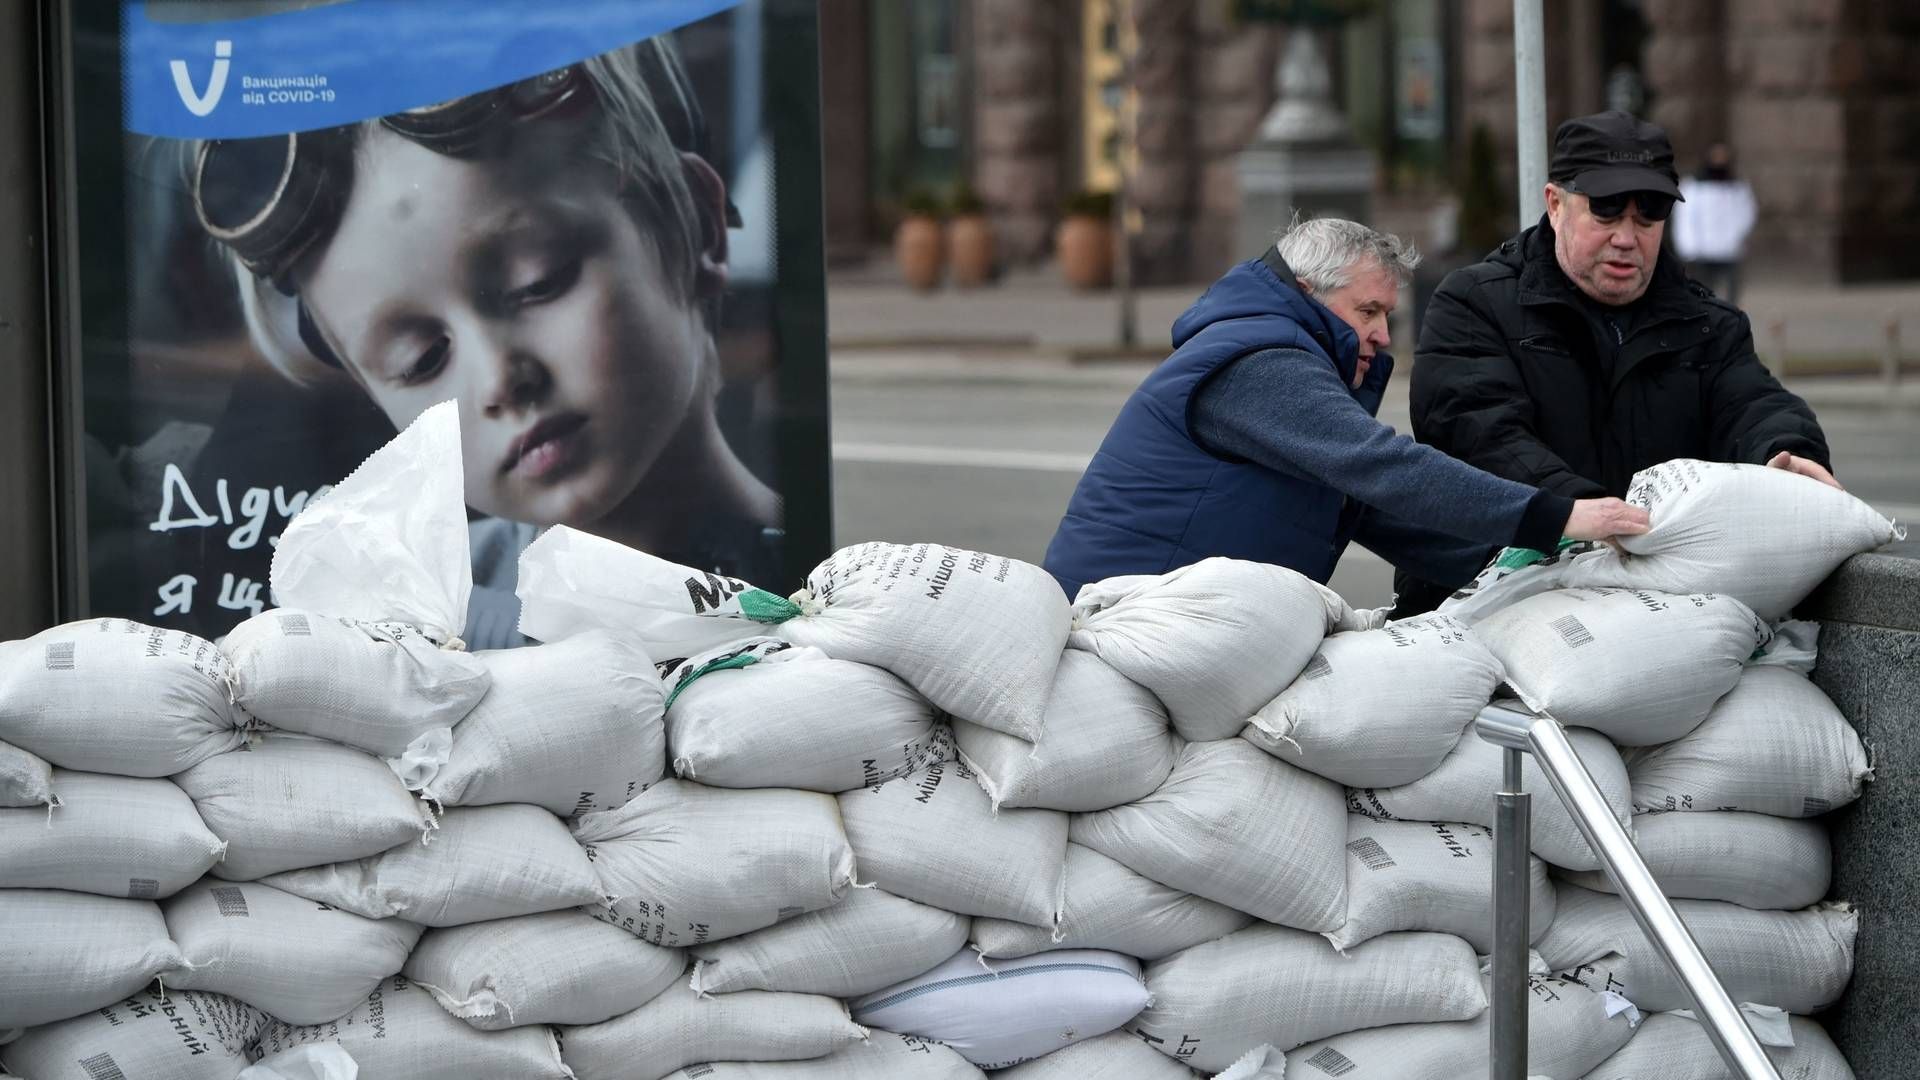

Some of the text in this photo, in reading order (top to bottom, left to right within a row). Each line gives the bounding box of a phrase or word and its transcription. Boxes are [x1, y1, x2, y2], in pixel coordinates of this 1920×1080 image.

[242, 74, 328, 91] Вакцинація
[242, 90, 336, 105] від COVID-19
[925, 552, 960, 601] мішок
